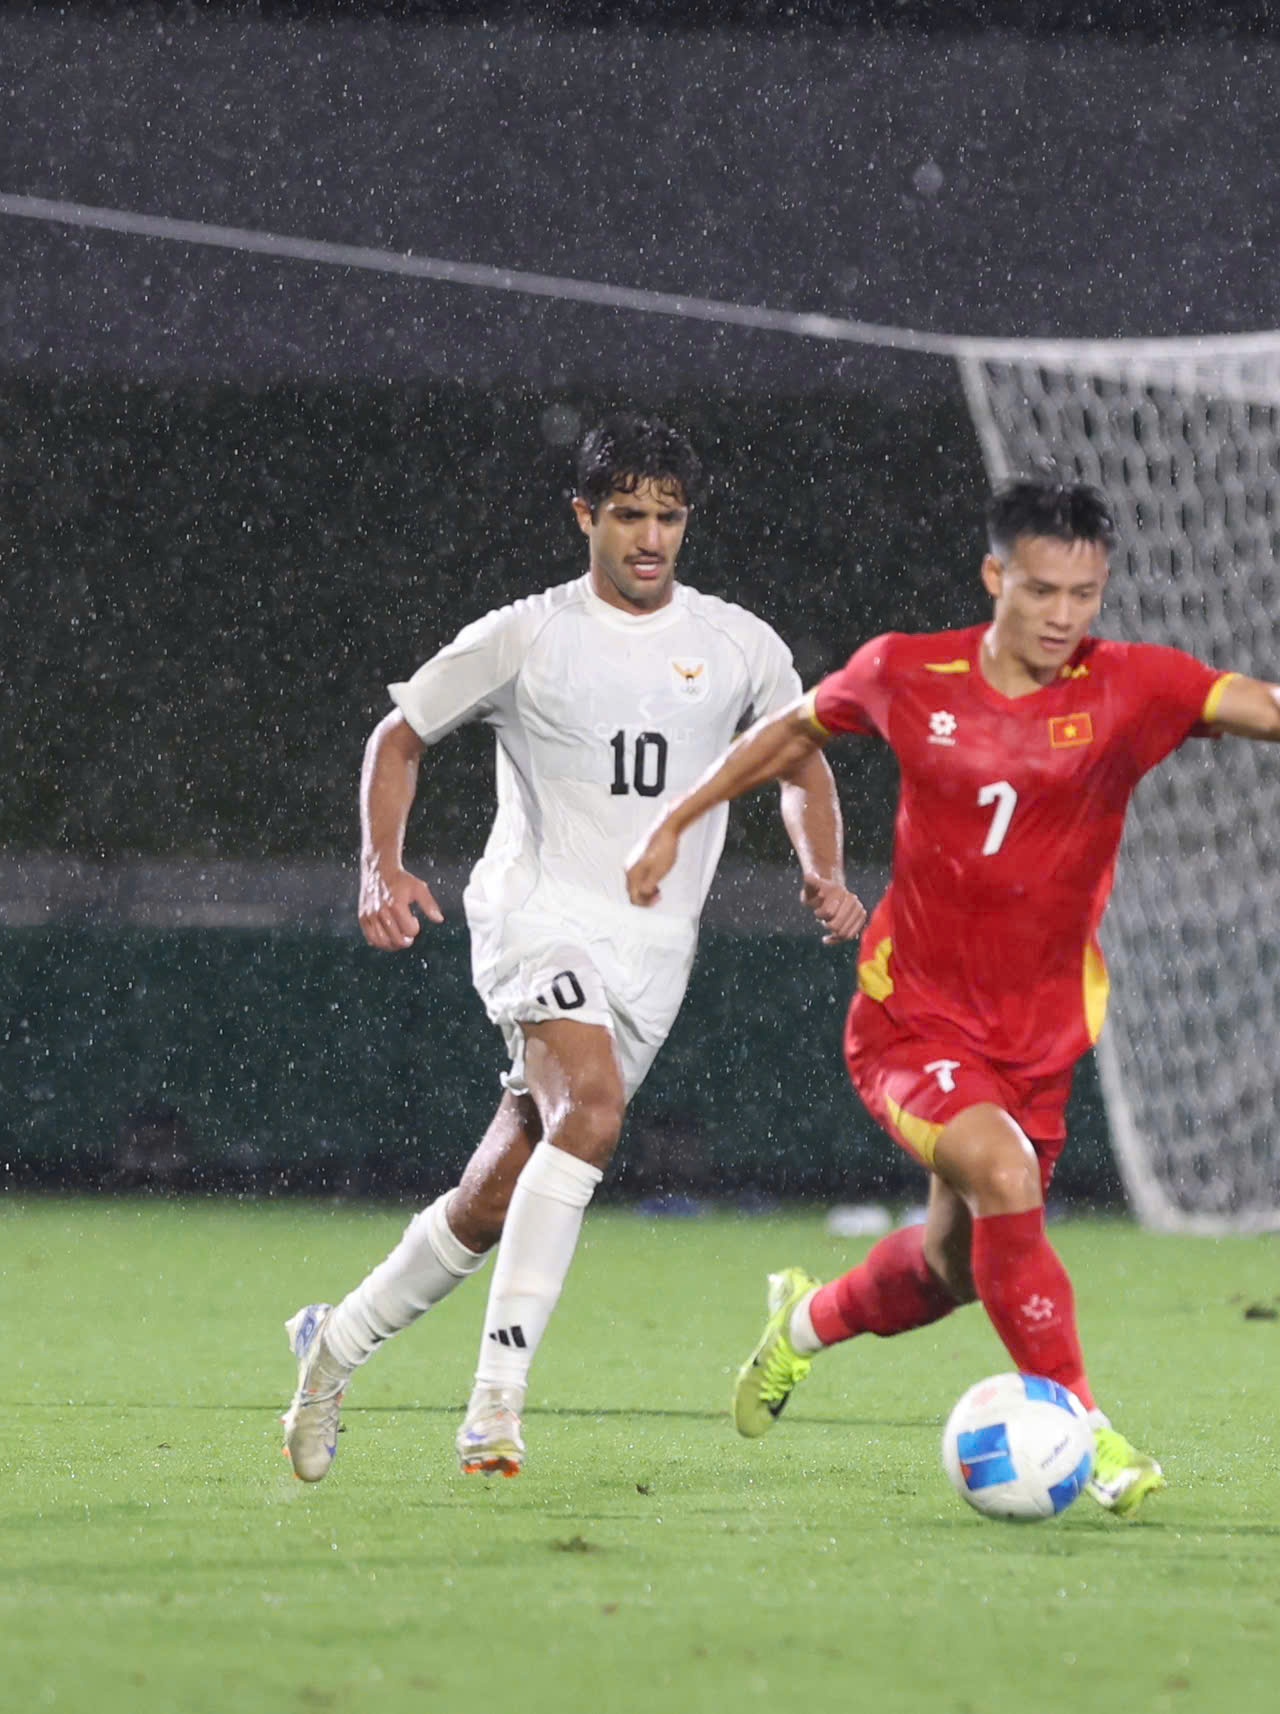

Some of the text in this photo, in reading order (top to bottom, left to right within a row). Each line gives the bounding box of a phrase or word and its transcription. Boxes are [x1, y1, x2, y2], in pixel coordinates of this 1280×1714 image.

[610, 730, 668, 797] 10
[977, 780, 1018, 856] 7
[536, 969, 586, 1010] 0
